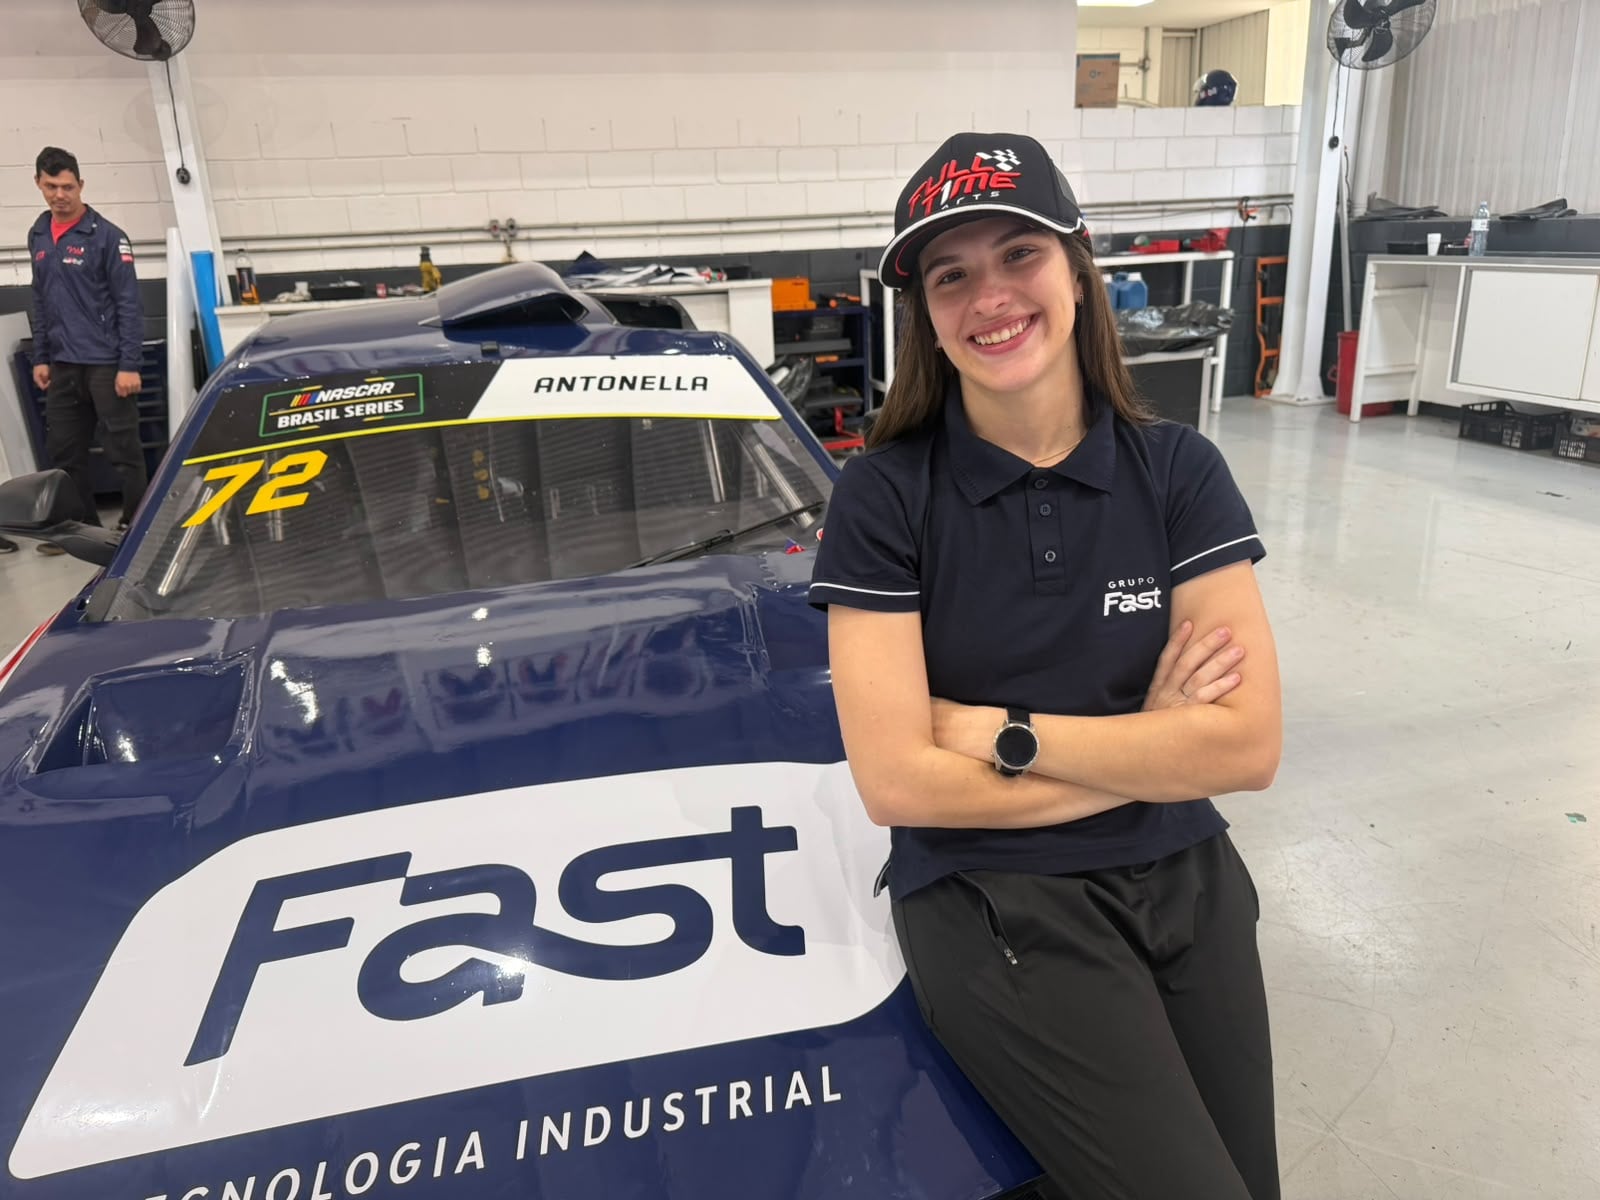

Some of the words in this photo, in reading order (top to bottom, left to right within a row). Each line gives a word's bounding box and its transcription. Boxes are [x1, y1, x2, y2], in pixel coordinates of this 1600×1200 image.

[315, 381, 395, 404] NASCAR
[534, 375, 708, 393] ANTONELLA
[277, 410, 340, 429] BRASIL
[344, 399, 404, 418] SERIES
[181, 449, 328, 528] 72
[1108, 576, 1155, 589] GRUPO
[1103, 586, 1162, 617] Fast
[183, 805, 806, 1067] Fast
[516, 1065, 842, 1160] INDUSTRIAL
